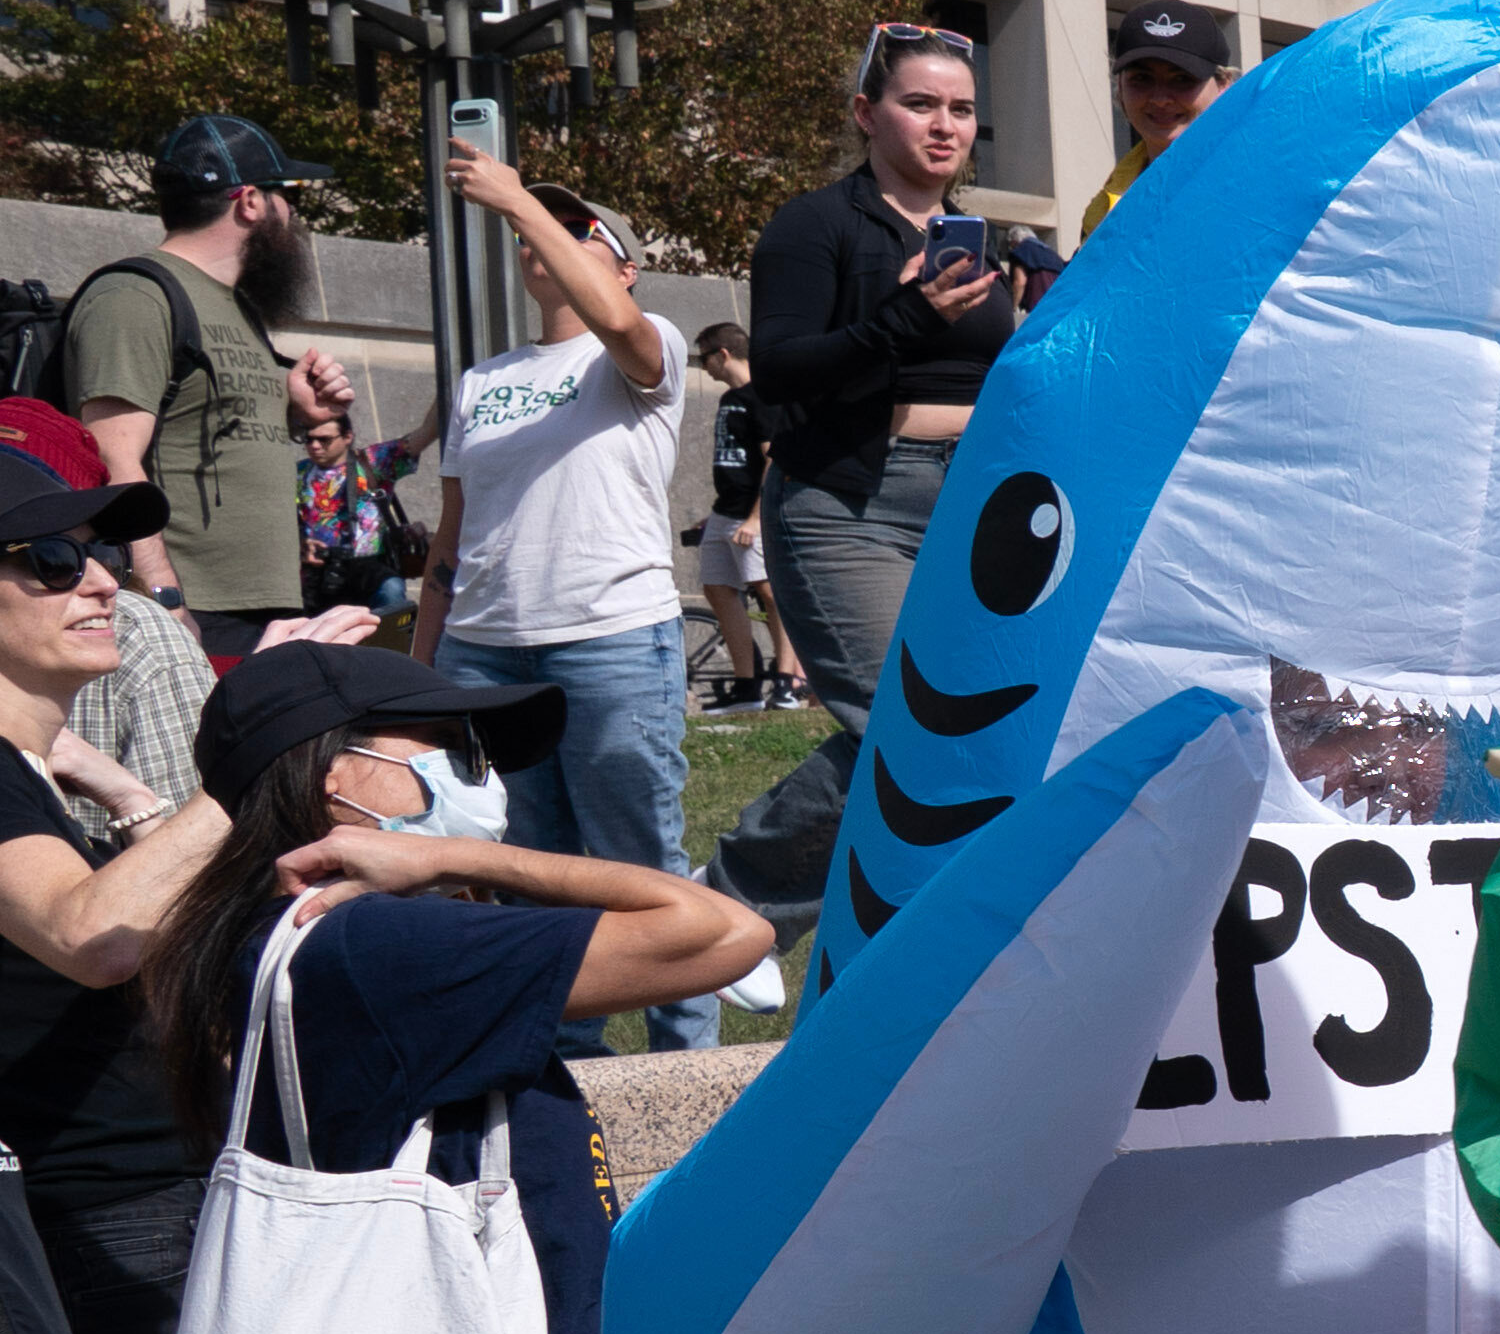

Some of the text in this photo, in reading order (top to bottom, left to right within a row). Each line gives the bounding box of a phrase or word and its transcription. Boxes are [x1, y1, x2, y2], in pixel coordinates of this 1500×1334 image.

[202, 323, 249, 347] WILL
[211, 347, 268, 372] TRADE
[217, 372, 284, 399] RACISTS
